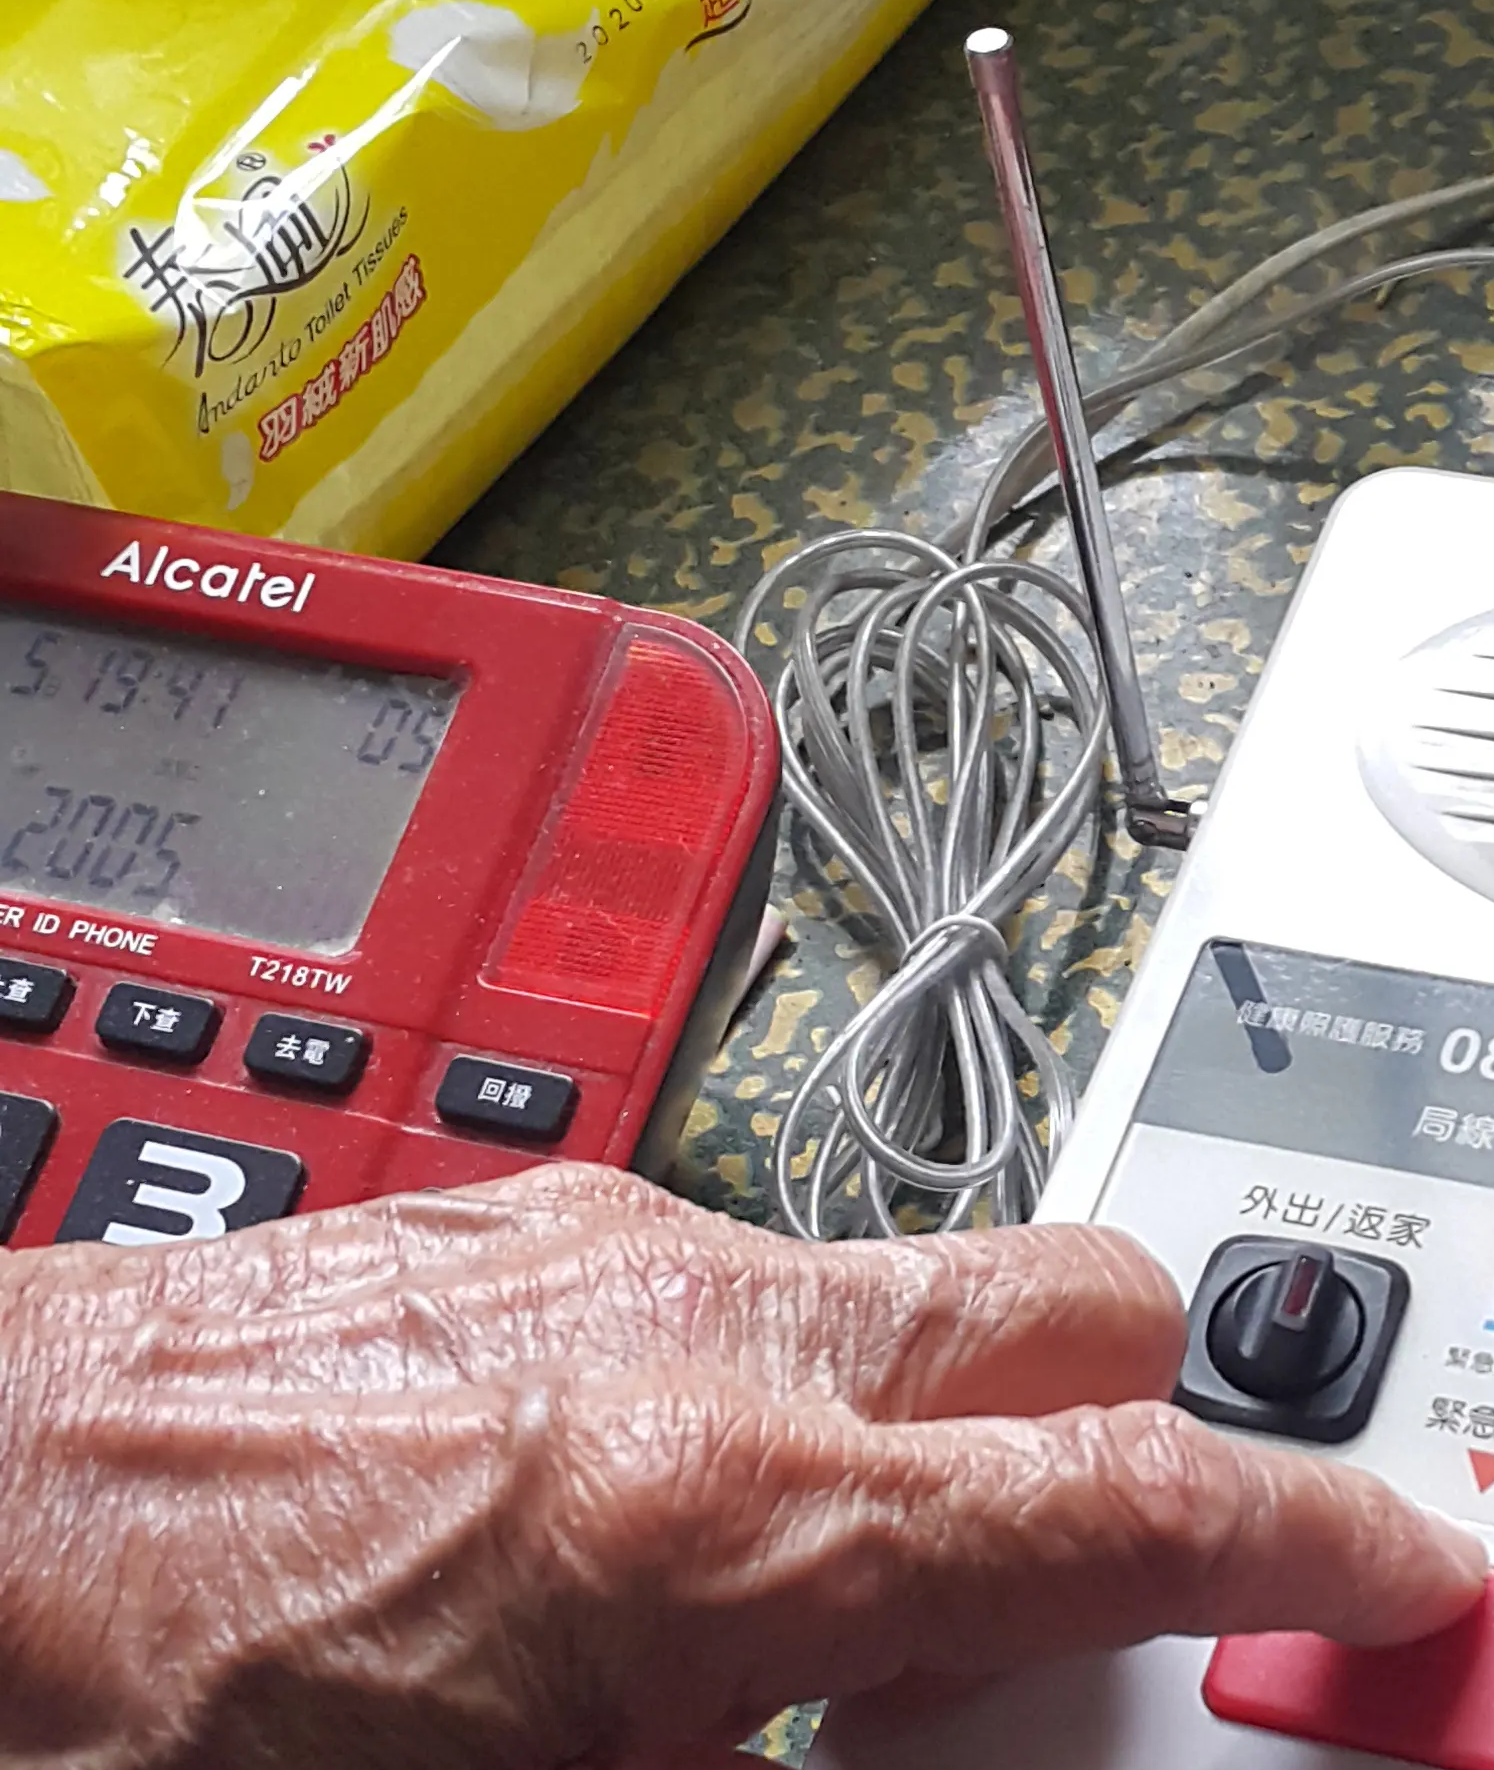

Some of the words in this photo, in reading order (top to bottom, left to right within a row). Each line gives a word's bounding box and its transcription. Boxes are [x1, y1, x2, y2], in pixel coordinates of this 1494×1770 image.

[303, 282, 352, 342] Toilet
[351, 205, 408, 286] Tissues
[101, 540, 316, 613] Alcatel
[32, 912, 61, 934] ID
[68, 919, 159, 956] PHONE
[249, 955, 353, 995] T218TW
[131, 1000, 183, 1035] 下查
[101, 1140, 246, 1247] 3
[1239, 1184, 1431, 1249] 外出/返家
